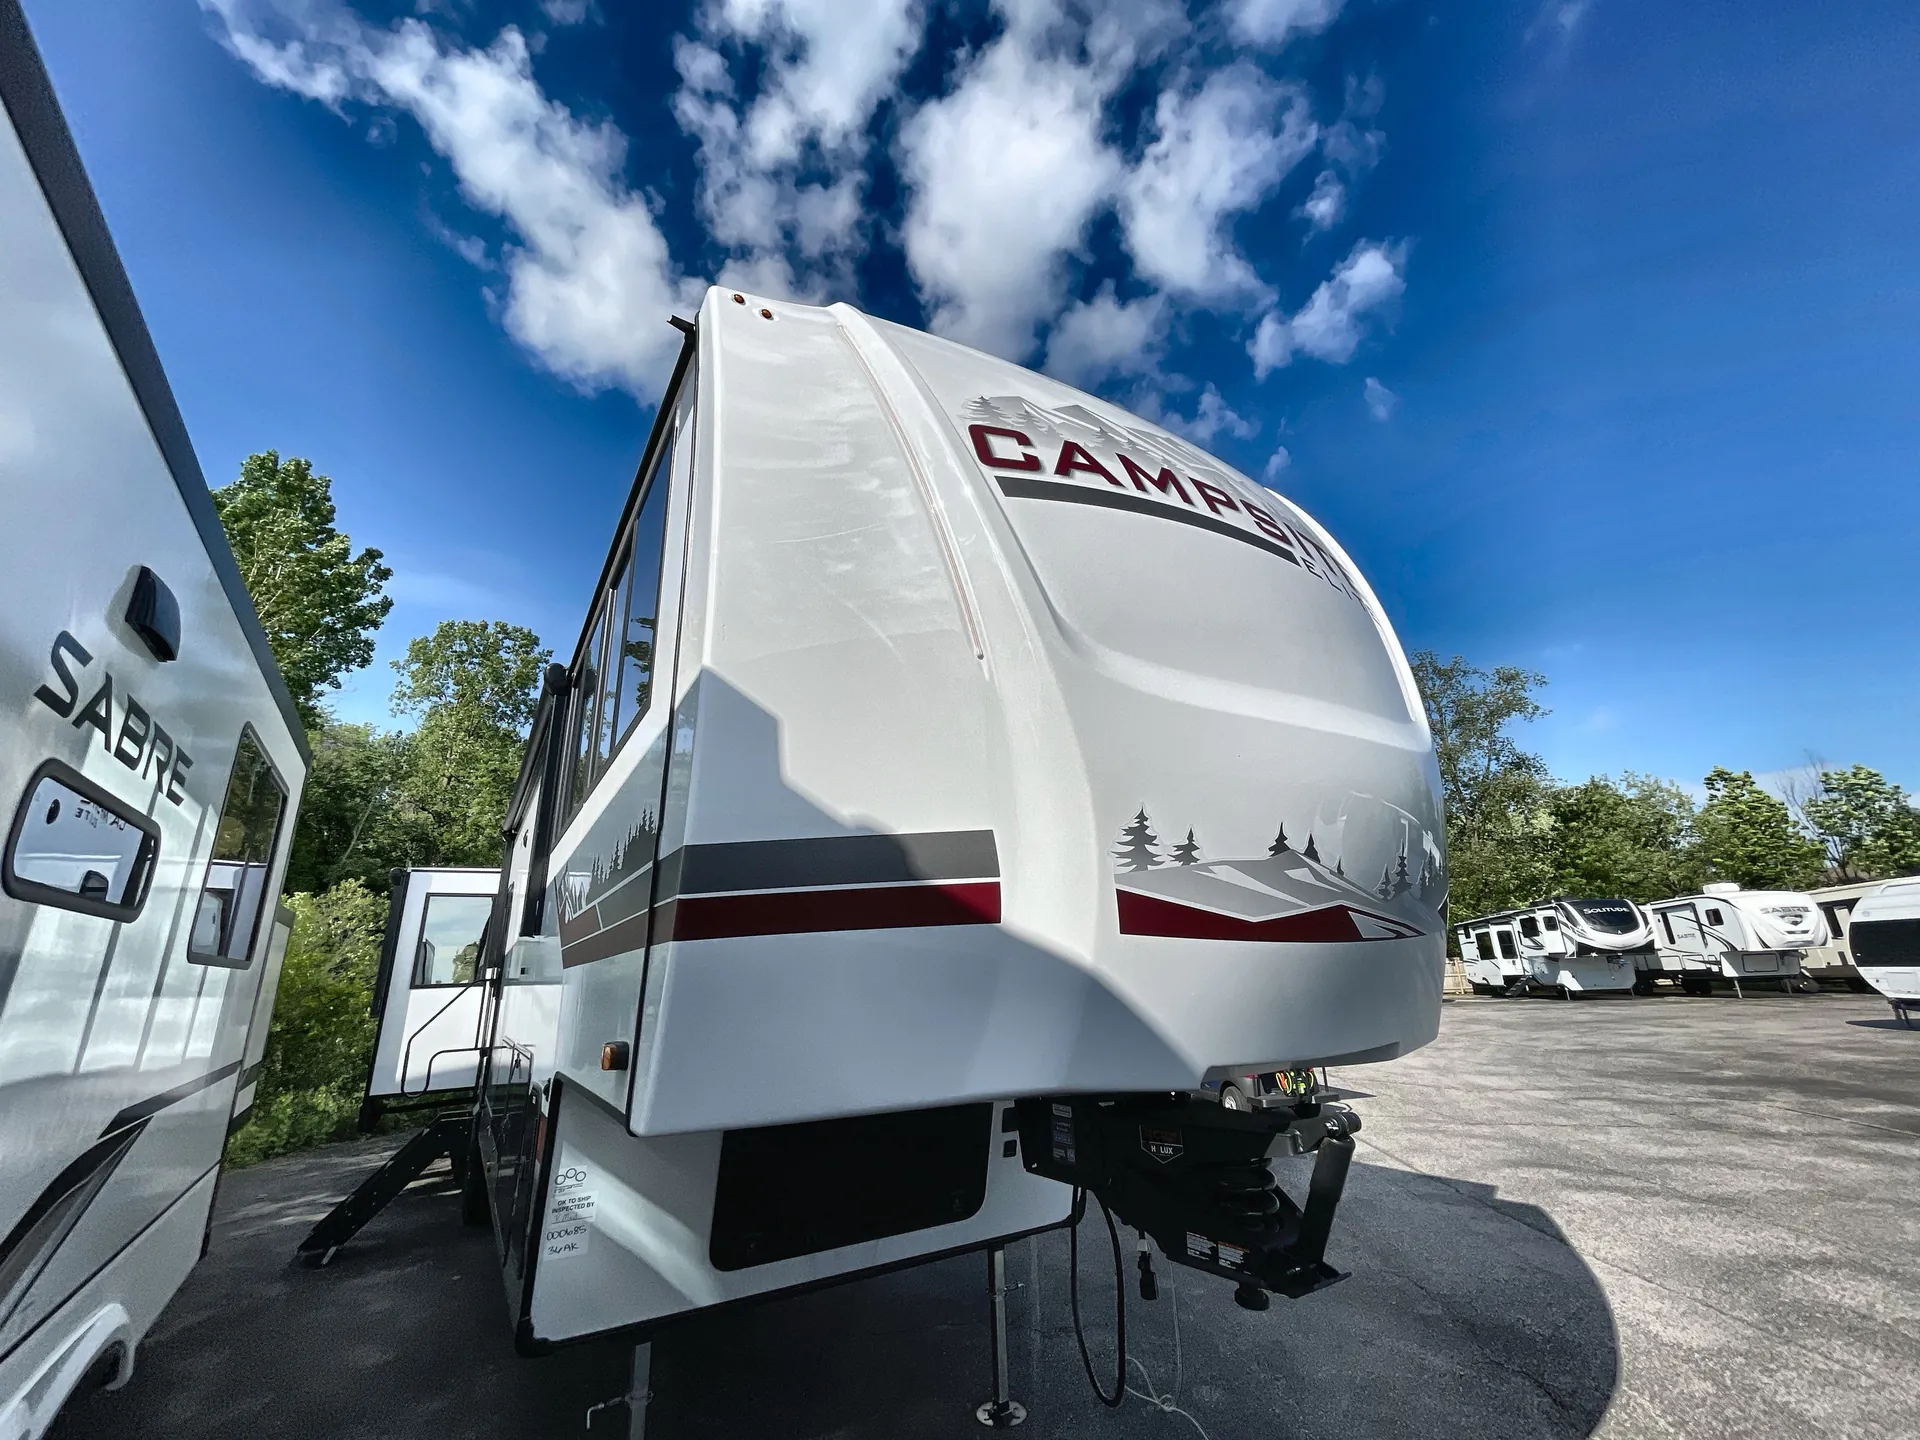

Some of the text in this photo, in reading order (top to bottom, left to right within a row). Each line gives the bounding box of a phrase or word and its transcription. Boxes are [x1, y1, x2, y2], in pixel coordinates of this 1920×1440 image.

[967, 424, 1360, 598] CAMPSIT
[1300, 556, 1376, 620] ELIT
[34, 630, 194, 806] SABRE
[1583, 907, 1630, 915] SOLITUDE
[1760, 906, 1812, 914] SABRE
[552, 1203, 585, 1213] INSPECTED
